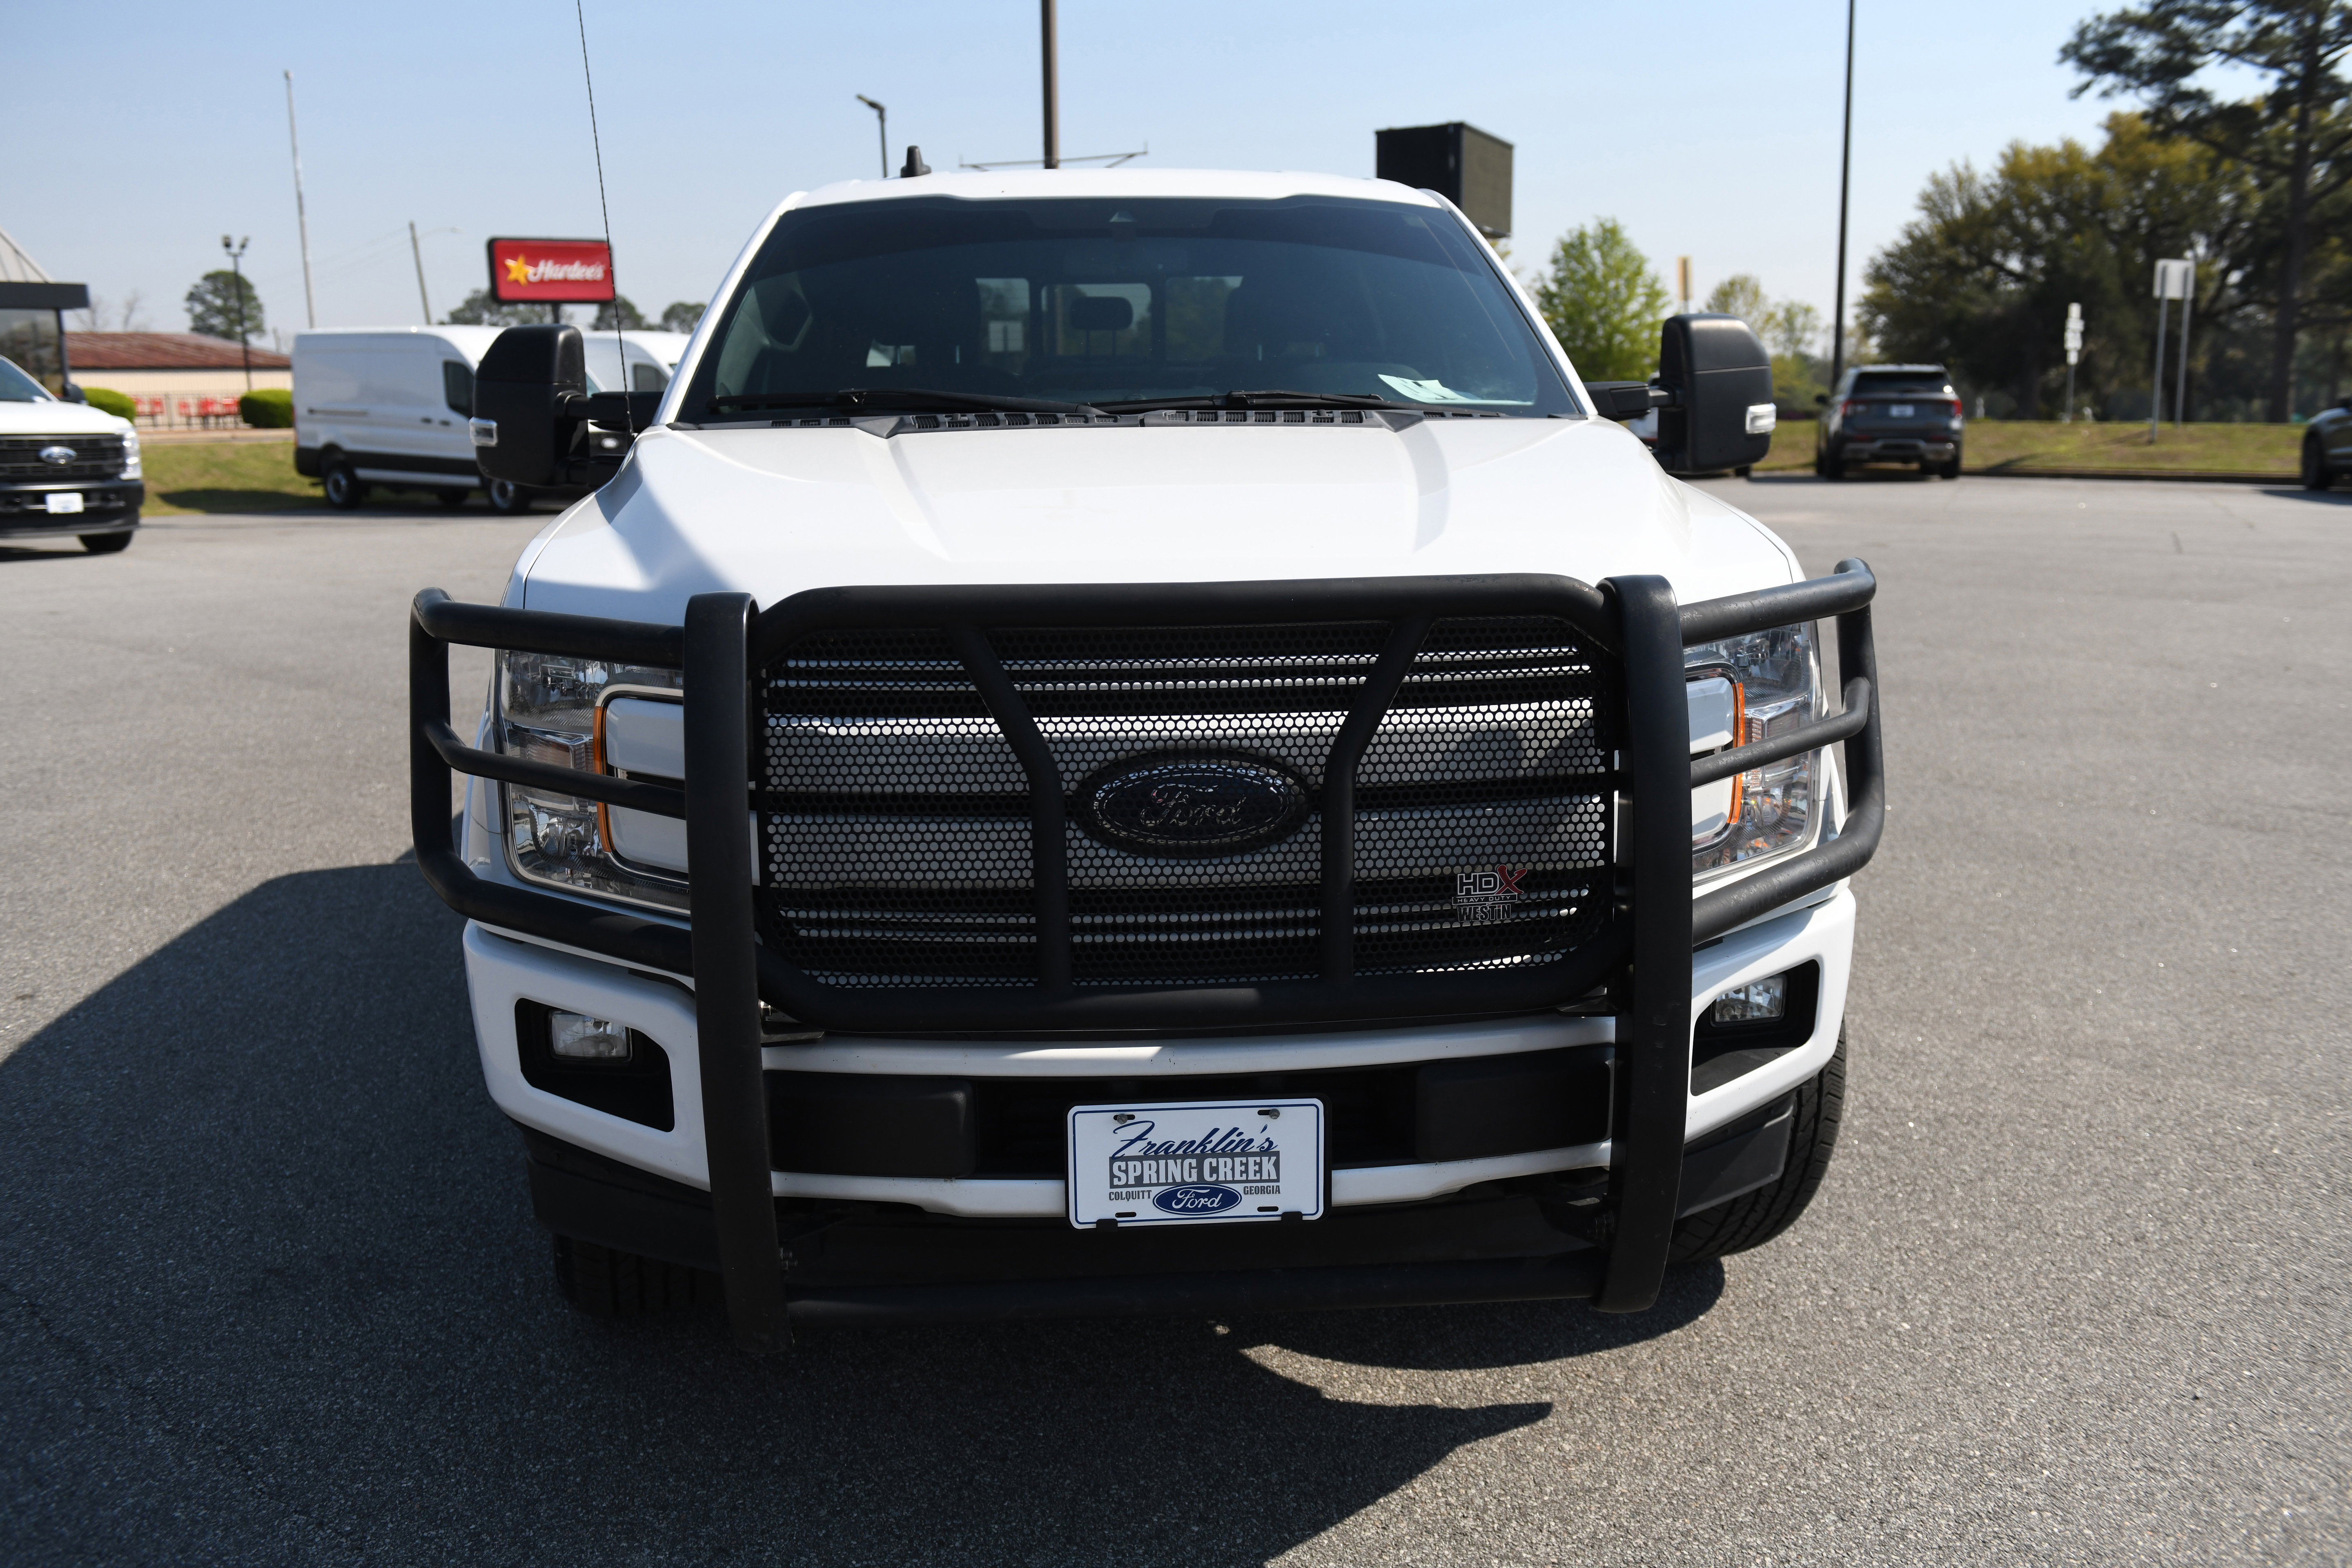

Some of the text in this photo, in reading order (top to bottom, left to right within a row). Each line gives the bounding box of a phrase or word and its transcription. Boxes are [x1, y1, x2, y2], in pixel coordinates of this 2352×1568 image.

[527, 259, 605, 282] Hardee's
[1457, 864, 1528, 895] HDX
[1111, 1120, 1279, 1160] Franklin's
[1112, 1156, 1277, 1185] SPRING CREEK
[1109, 1189, 1152, 1201] COLQUITT
[1172, 1188, 1223, 1209] Ford
[1243, 1185, 1281, 1196] GEORGIA
